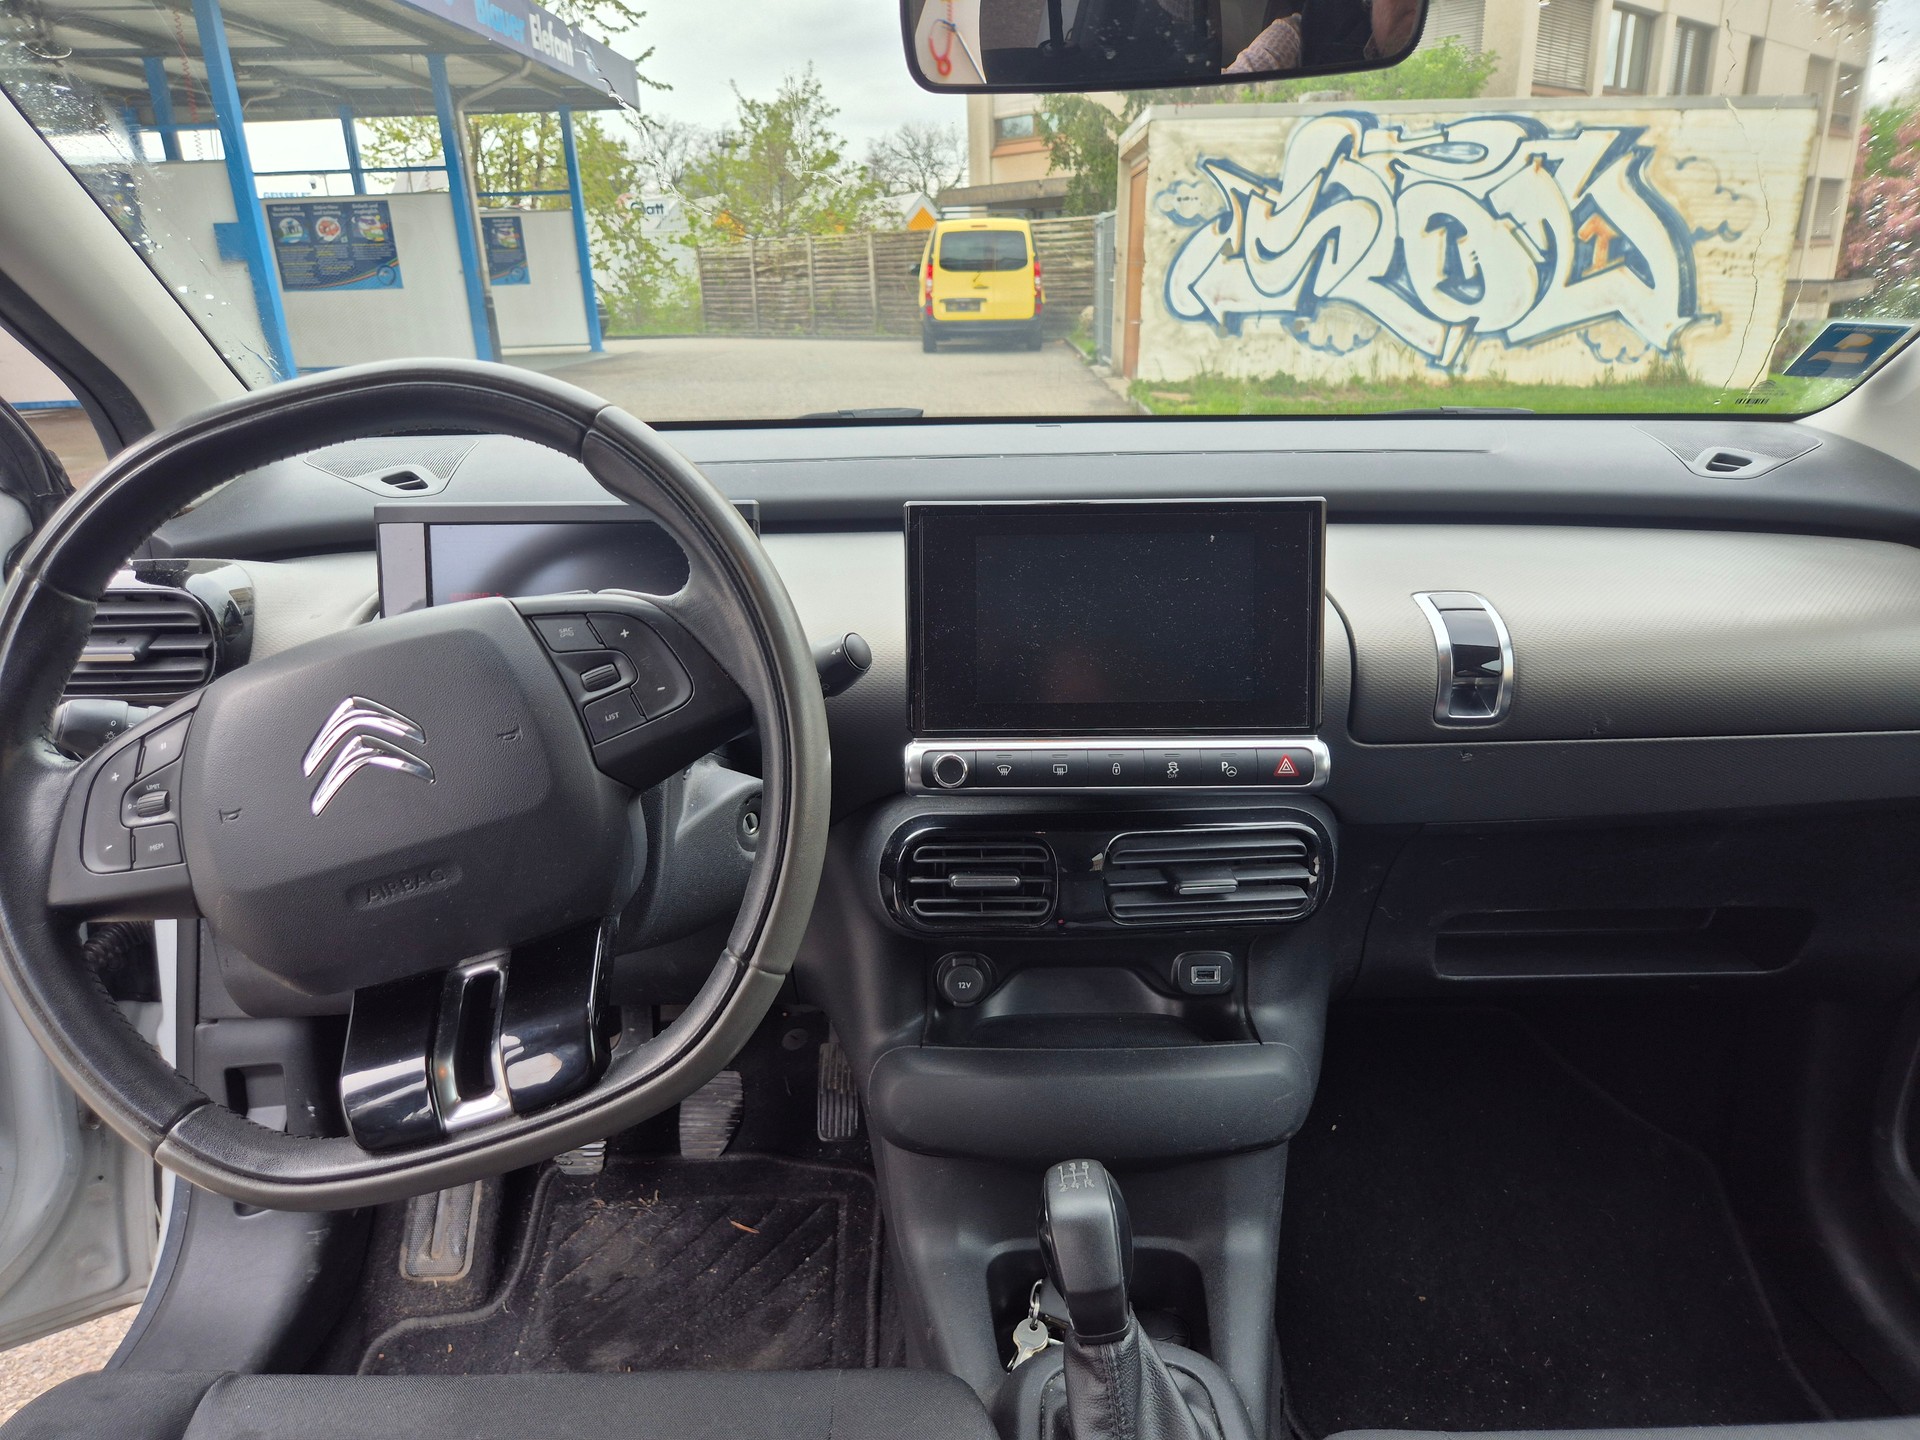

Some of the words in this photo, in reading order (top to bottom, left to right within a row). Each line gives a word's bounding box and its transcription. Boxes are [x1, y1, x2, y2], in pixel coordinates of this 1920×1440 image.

[529, 13, 575, 67] Elefant
[605, 712, 620, 721] LIST
[146, 783, 160, 791] LIMIT
[150, 843, 164, 851] MEM
[957, 981, 972, 990] 12V
